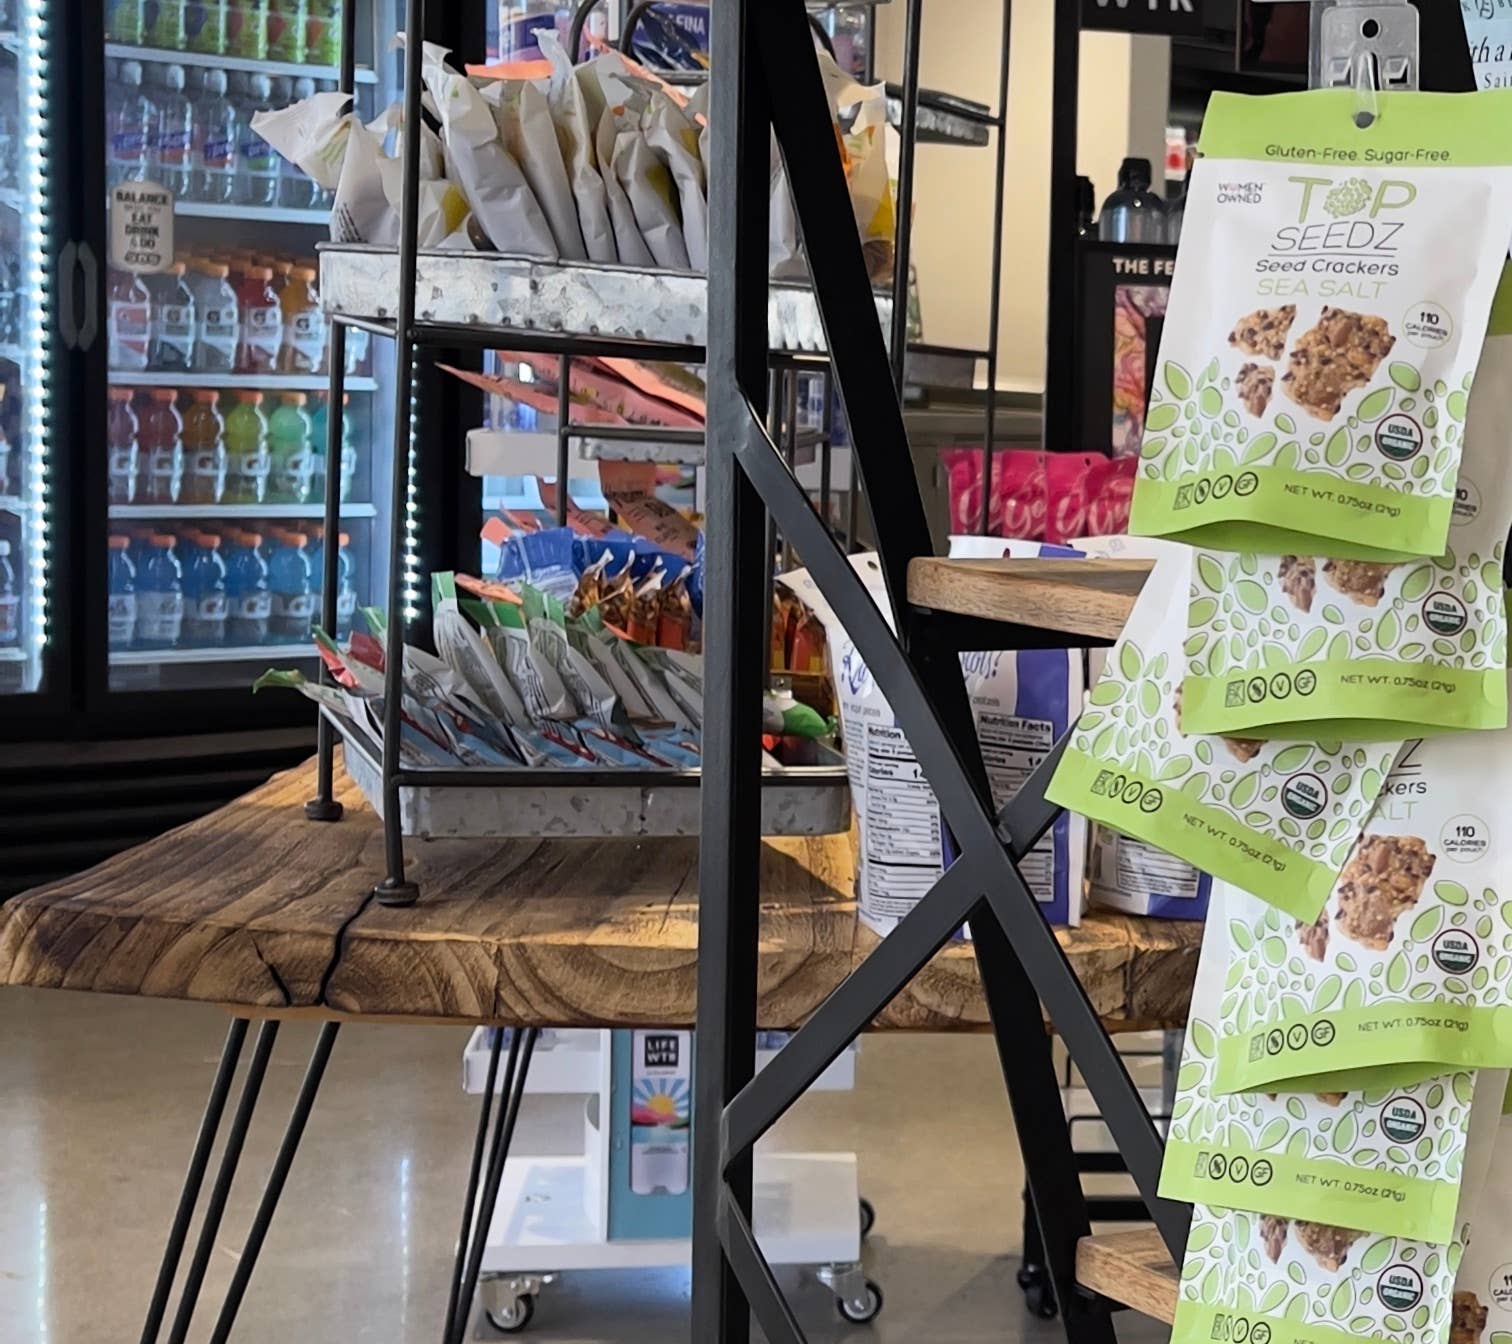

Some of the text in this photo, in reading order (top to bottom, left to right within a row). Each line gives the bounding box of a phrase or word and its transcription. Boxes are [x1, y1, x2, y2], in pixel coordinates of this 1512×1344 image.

[1216, 193, 1262, 204] OWNED
[1271, 221, 1405, 252] SEEDZ
[1112, 258, 1175, 275] THE FE
[1255, 258, 1400, 277] Seed Crackers
[1256, 278, 1388, 299] SEA SALT
[1419, 311, 1440, 326] 110
[1388, 423, 1414, 438] USDA
[1284, 482, 1308, 498] NET
[1312, 487, 1335, 504] WT.
[1433, 601, 1458, 614] USDA
[1340, 673, 1364, 686] NET
[1366, 673, 1391, 686] WT.
[1021, 721, 1051, 733] Facts
[1295, 781, 1320, 799] USDA
[1183, 811, 1206, 828] NET
[1454, 824, 1476, 838] 110
[1443, 837, 1487, 847] CALORIES
[1443, 939, 1469, 952] USDA
[1357, 1020, 1380, 1033] NET
[1406, 1016, 1442, 1029] 0.75oz
[1391, 1106, 1417, 1119] USDA
[1295, 1172, 1318, 1185] NET
[1344, 1180, 1379, 1197] 0.75oz
[1389, 1275, 1414, 1287] USDA
